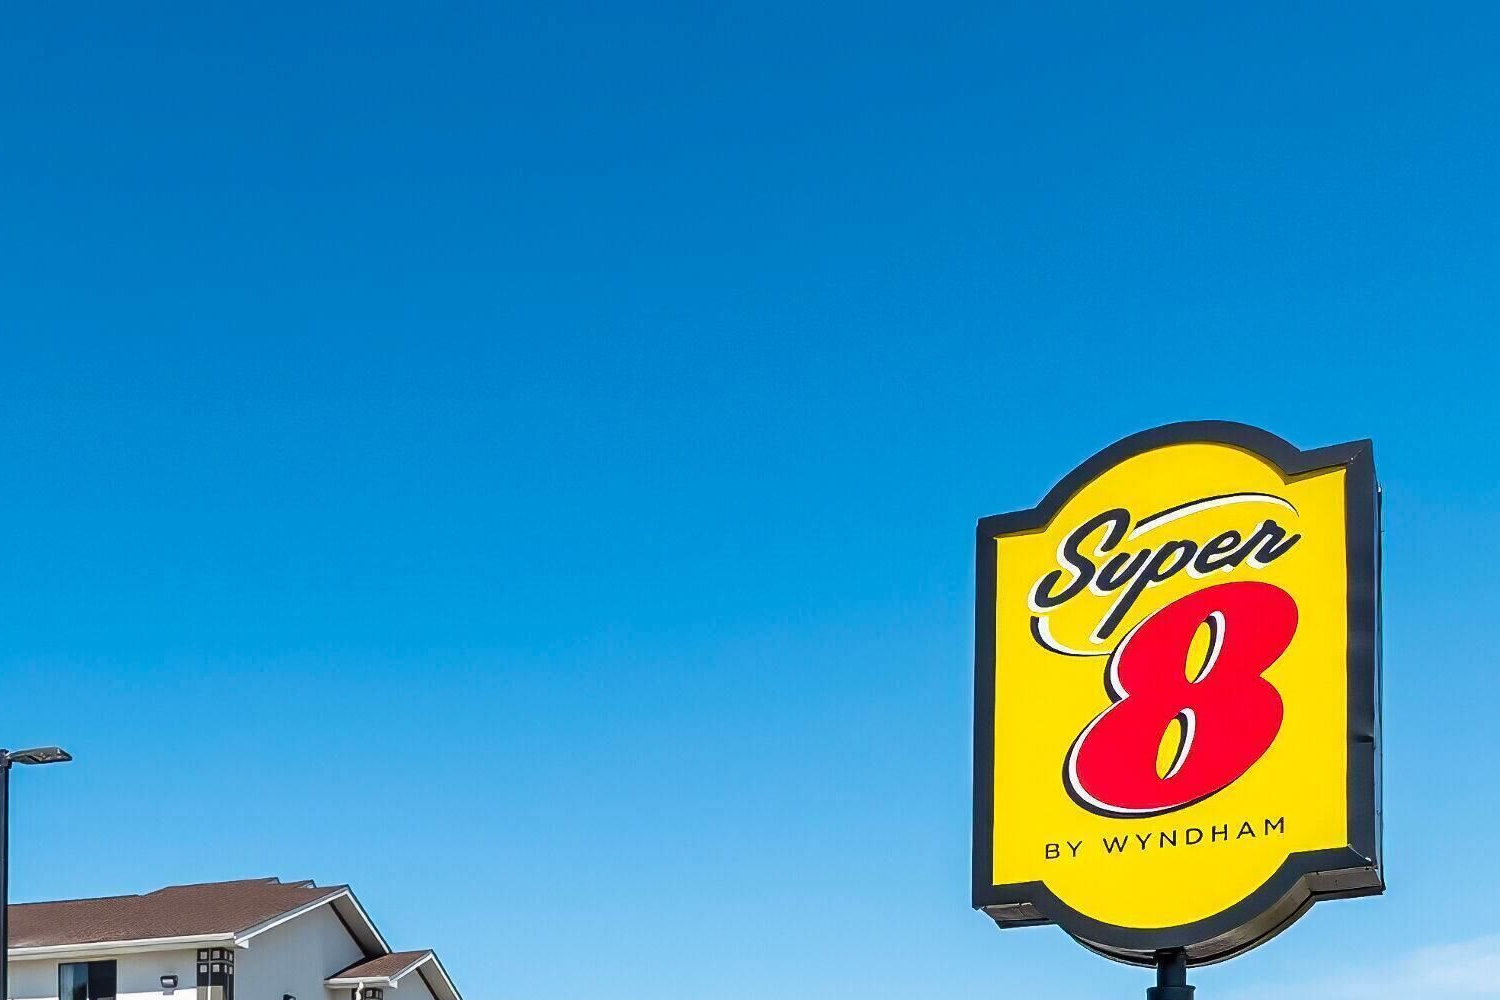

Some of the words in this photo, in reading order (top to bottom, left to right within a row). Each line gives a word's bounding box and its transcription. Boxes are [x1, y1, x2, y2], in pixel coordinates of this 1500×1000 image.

[1029, 505, 1302, 644] Super
[1061, 581, 1299, 819] 8
[1044, 841, 1083, 860] BY
[1102, 816, 1286, 854] WYNDHAM
